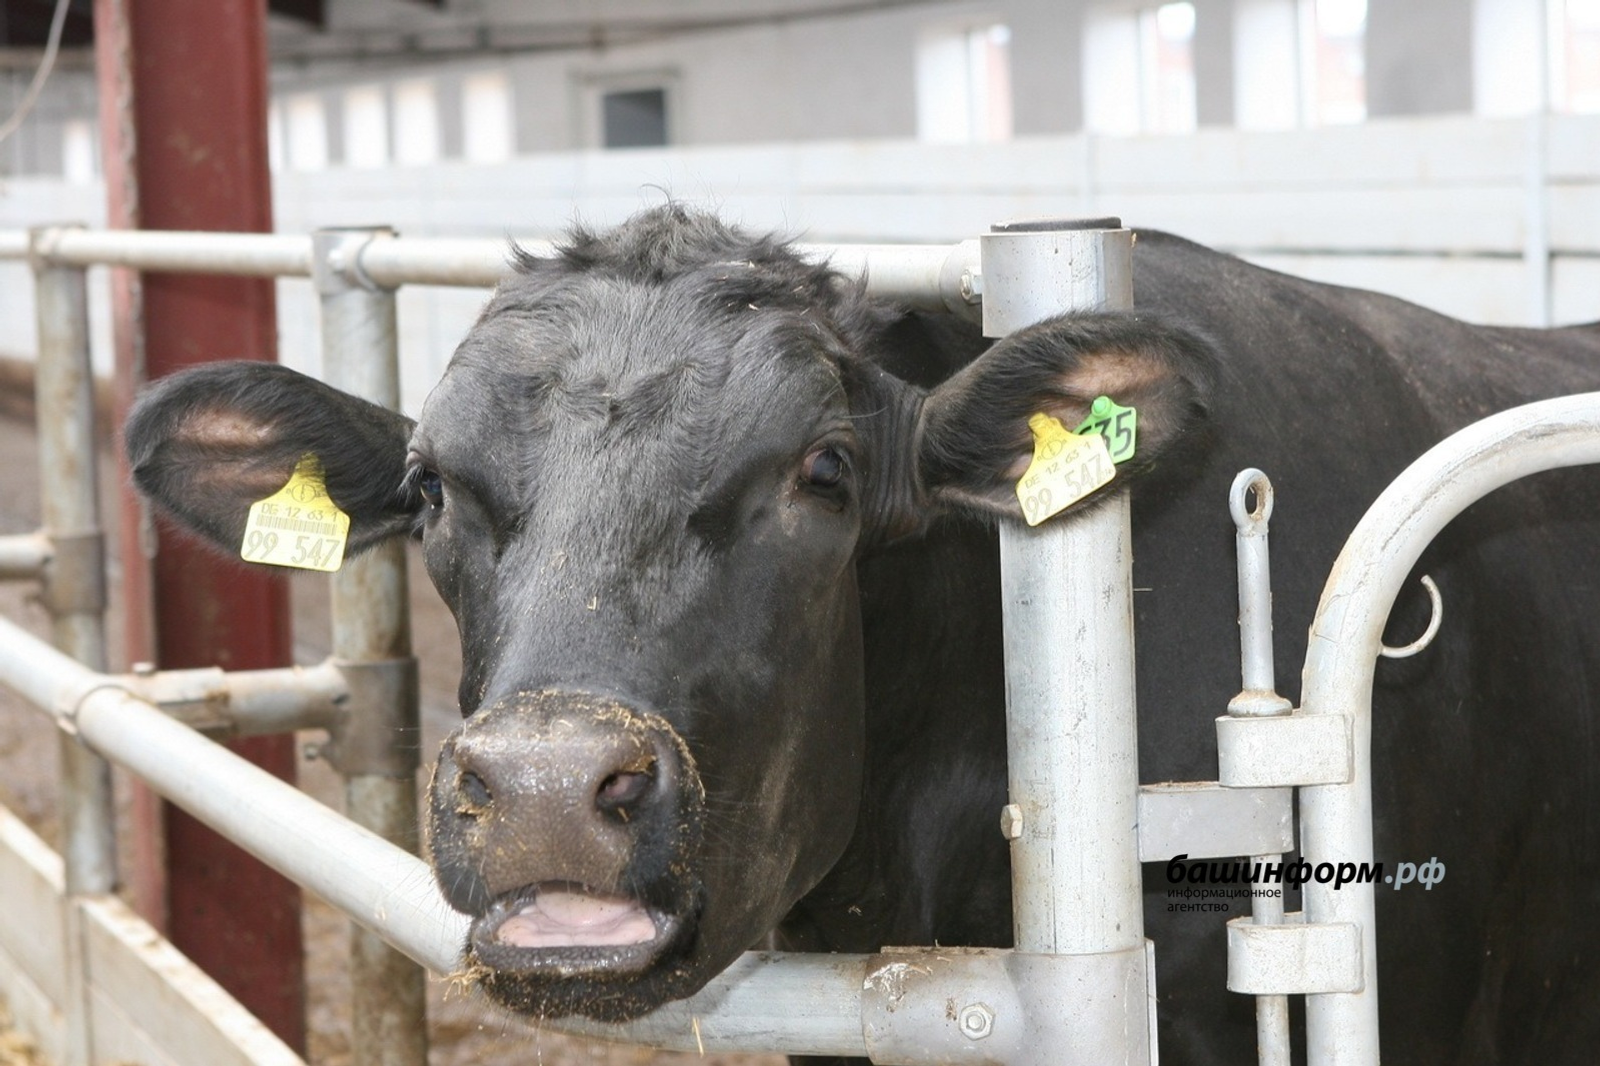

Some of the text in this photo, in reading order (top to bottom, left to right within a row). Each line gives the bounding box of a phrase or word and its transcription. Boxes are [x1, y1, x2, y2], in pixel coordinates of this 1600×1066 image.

[1079, 410, 1132, 457] 35
[1024, 473, 1041, 490] DE
[1045, 462, 1060, 476] 12
[1024, 453, 1101, 524] 99 547
[285, 506, 301, 519] 12
[307, 509, 324, 521] 63
[244, 530, 341, 568] 99 547
